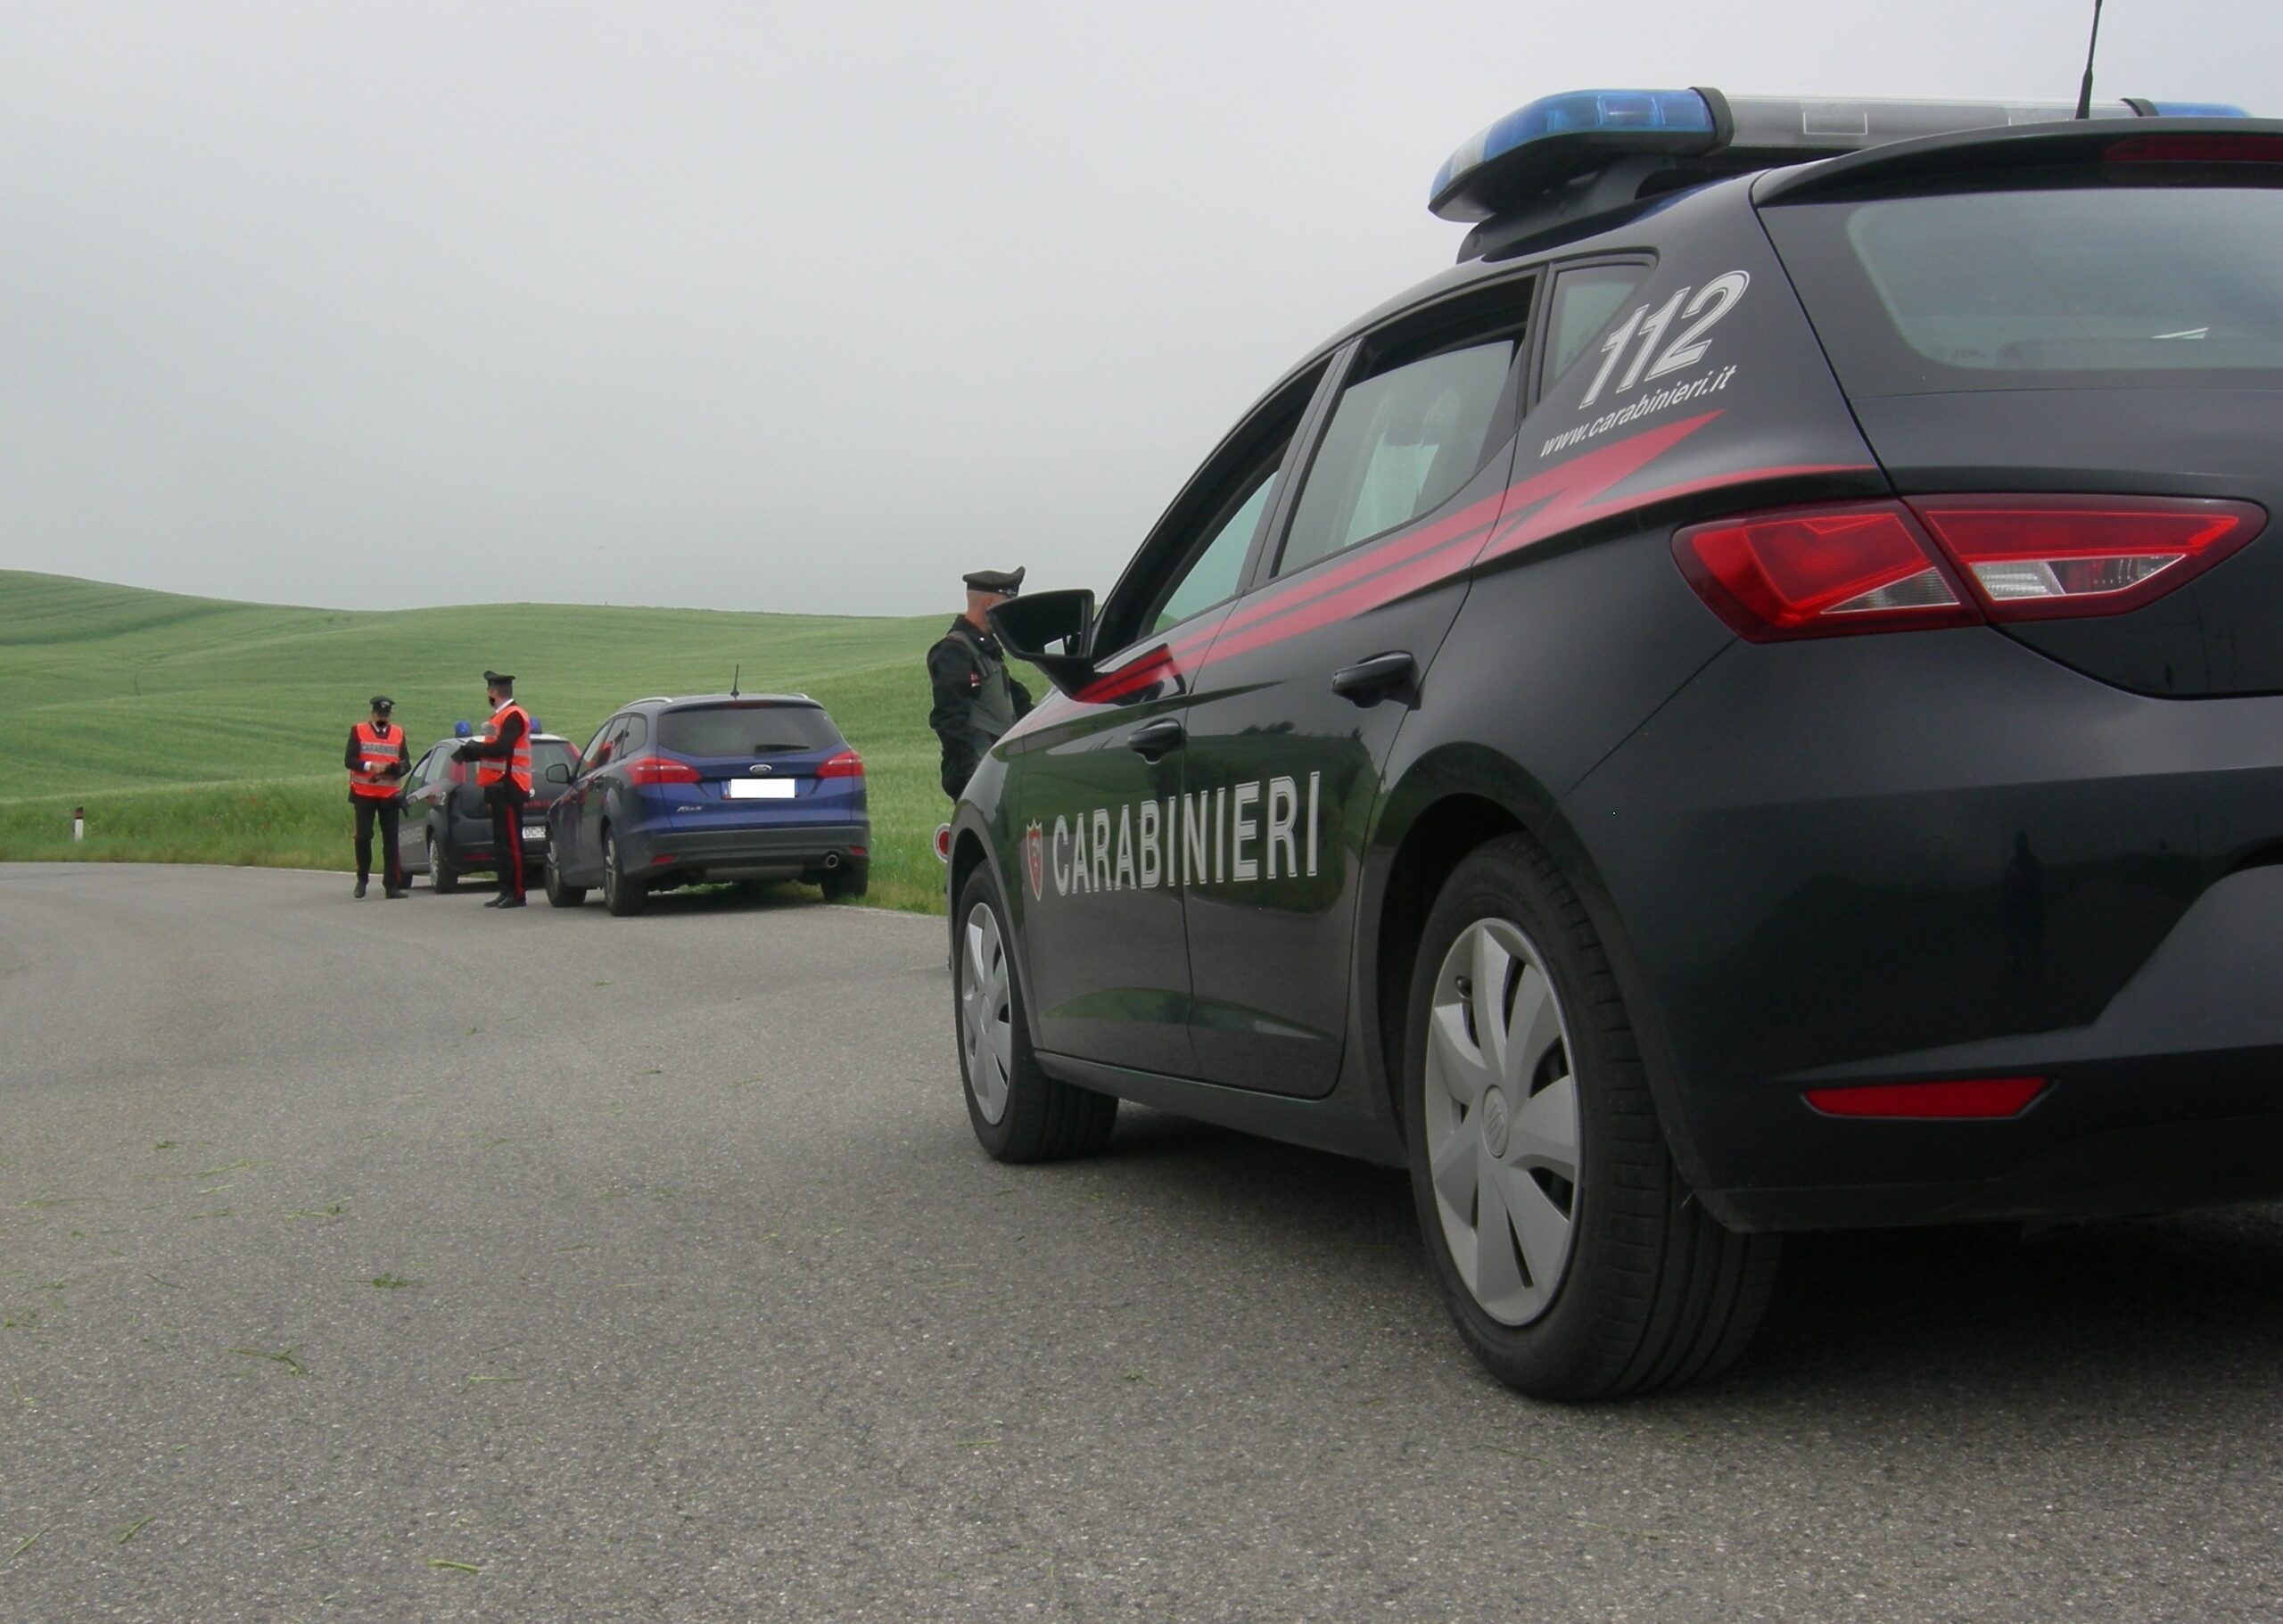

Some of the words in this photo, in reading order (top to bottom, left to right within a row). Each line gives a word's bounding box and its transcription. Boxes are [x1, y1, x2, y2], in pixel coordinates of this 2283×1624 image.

[1578, 270, 1750, 409] 112
[1540, 365, 1737, 458] www.carabinieri.it
[1053, 771, 1320, 895] CARABINIERI
